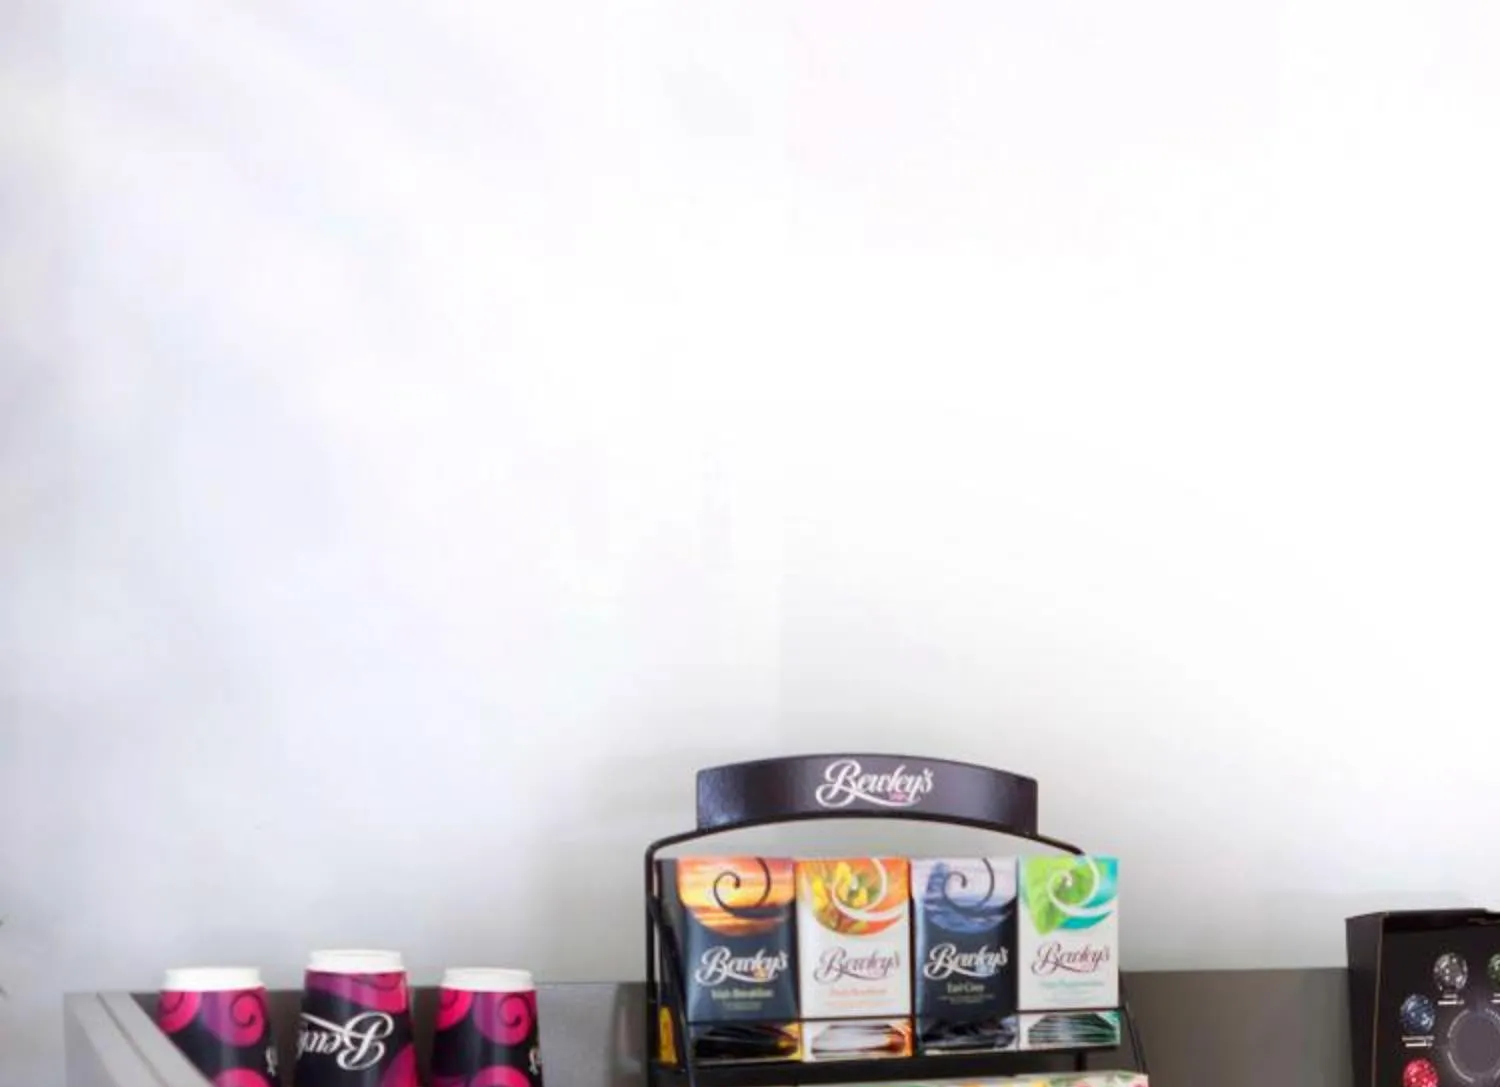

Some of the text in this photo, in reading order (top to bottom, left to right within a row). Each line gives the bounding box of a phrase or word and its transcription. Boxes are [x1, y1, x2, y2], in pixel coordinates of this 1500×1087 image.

[815, 759, 934, 809] Bewley's
[695, 946, 789, 987] Bewley's
[923, 943, 1009, 980] Bewley's
[1031, 941, 1111, 976] Bewley's
